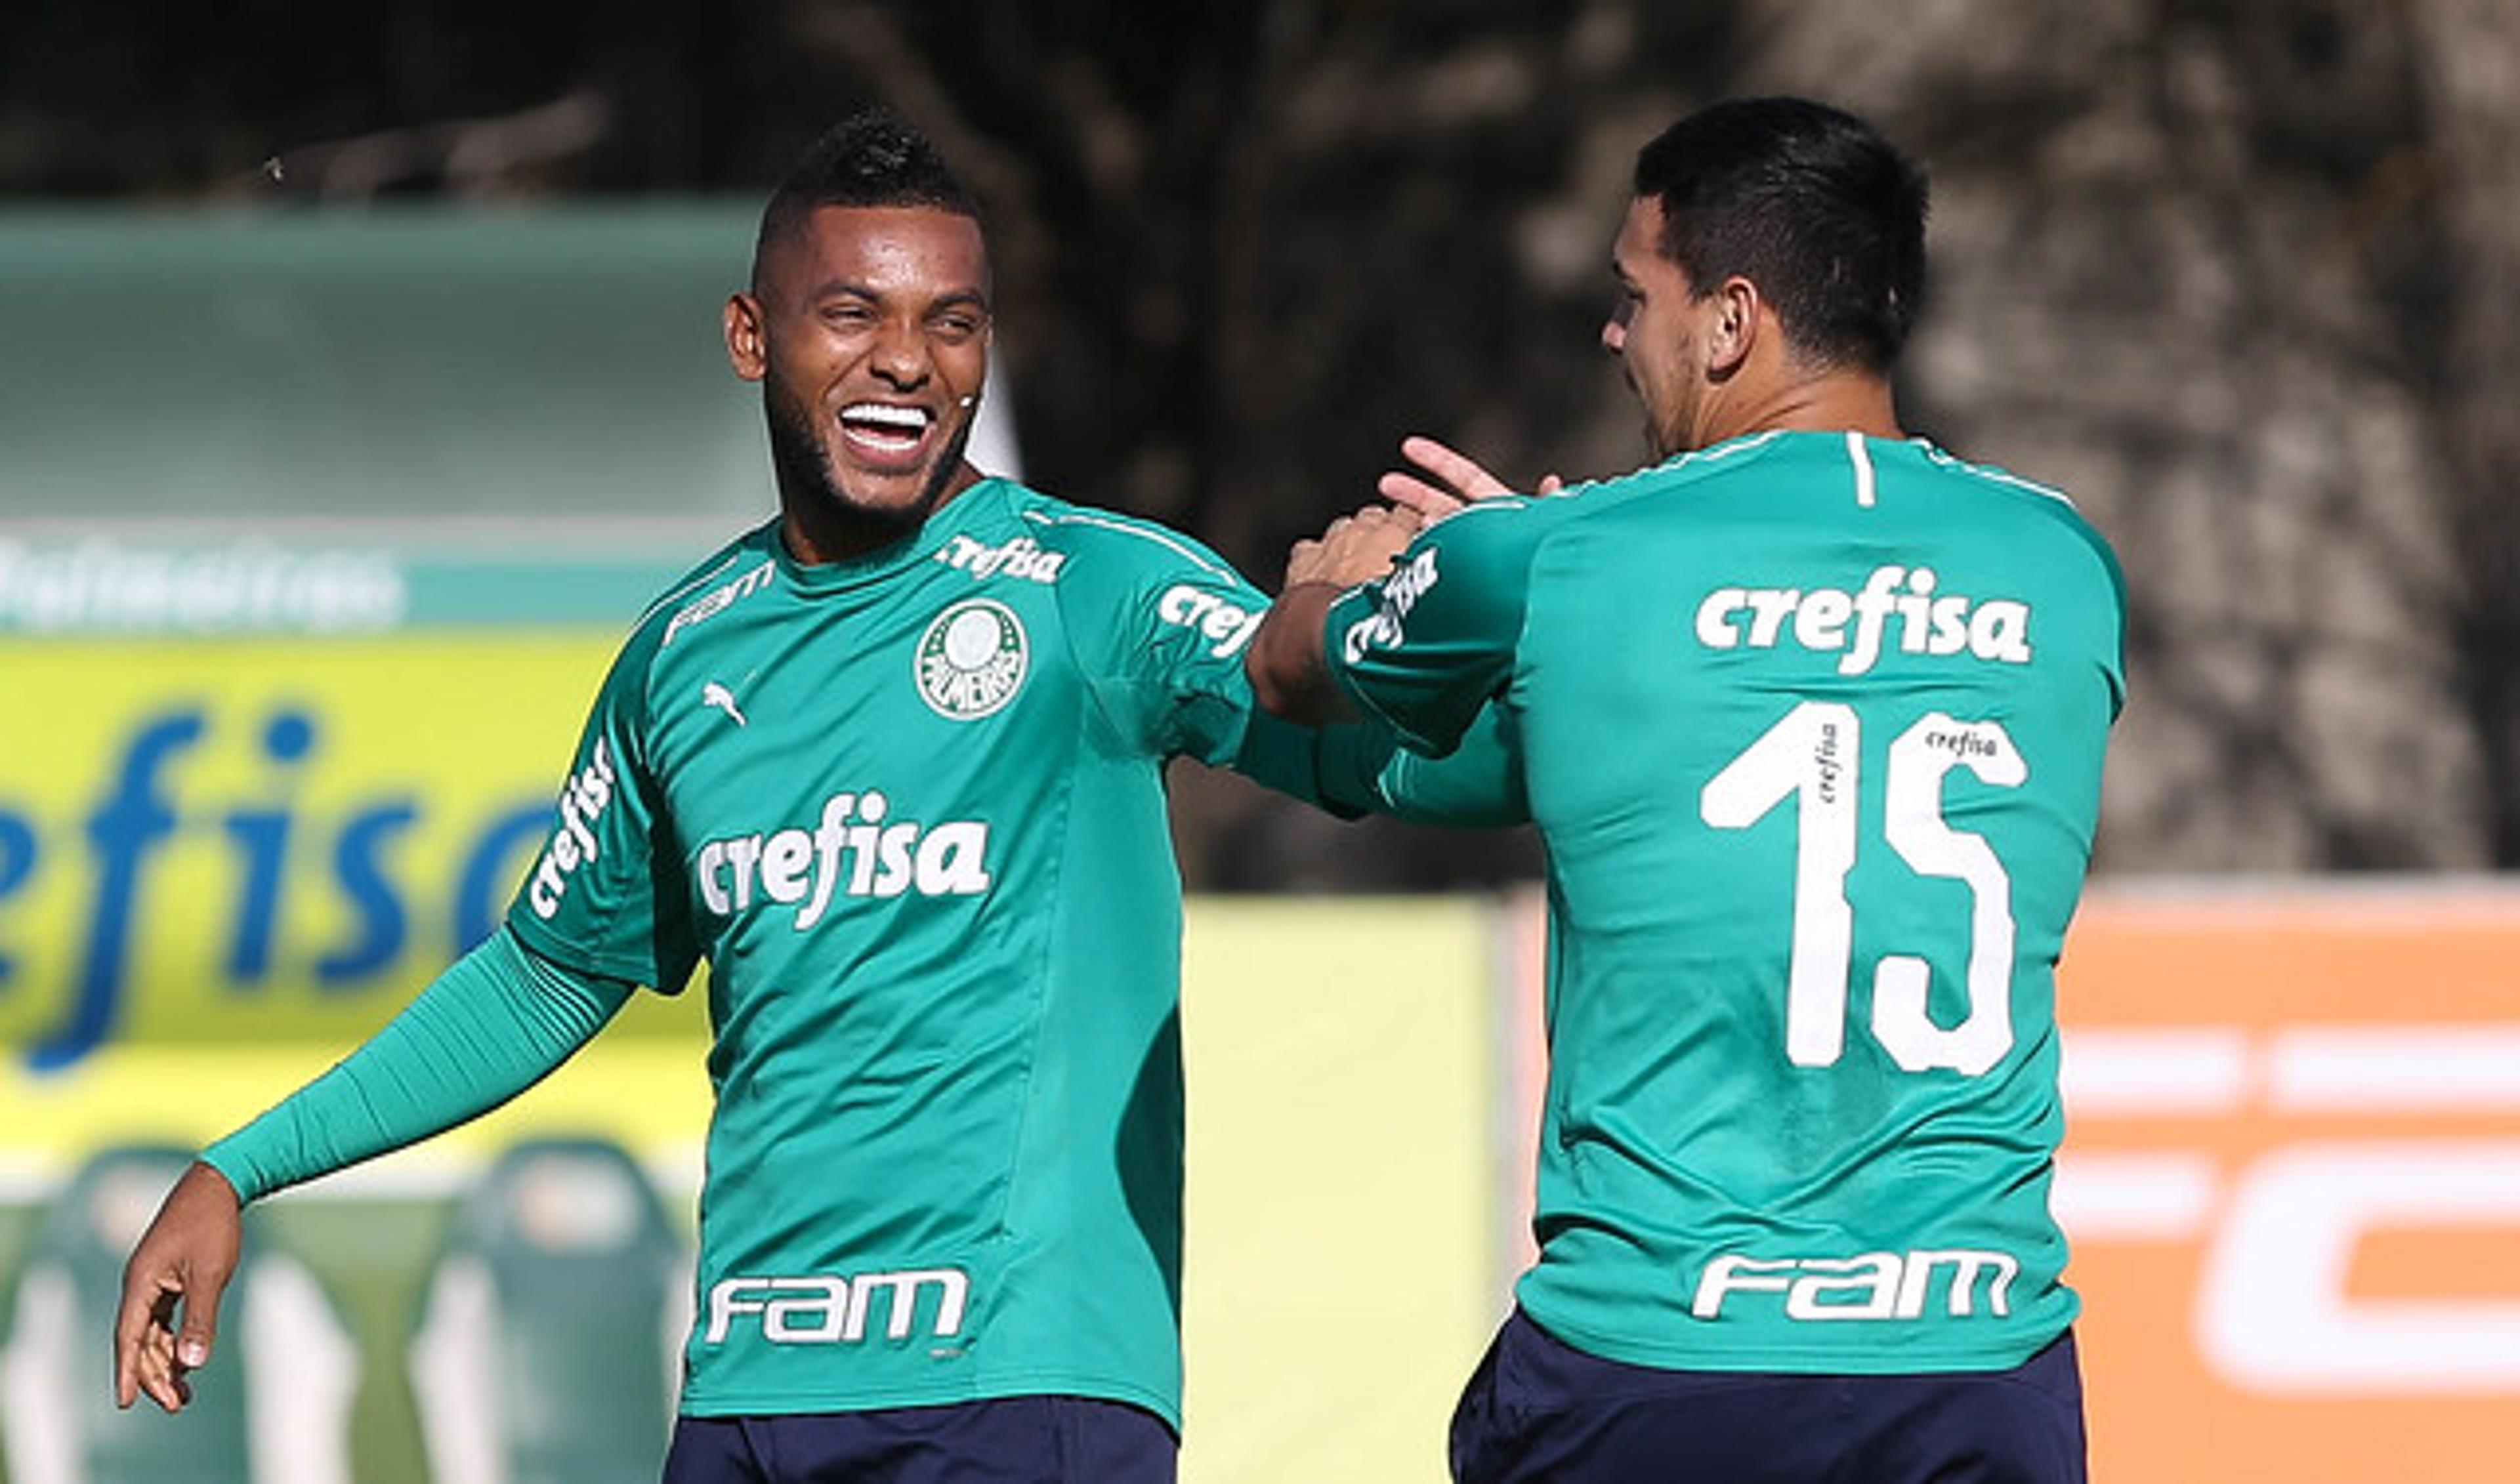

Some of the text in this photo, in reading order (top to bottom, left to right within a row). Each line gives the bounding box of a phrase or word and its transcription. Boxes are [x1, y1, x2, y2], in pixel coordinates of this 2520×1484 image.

[1695, 566, 2032, 676] crefisa
[1814, 724, 1843, 804] crefisa
[1925, 730, 1996, 758] crefisa
[698, 791, 990, 930] crefisa
[1700, 700, 2028, 1077] 15
